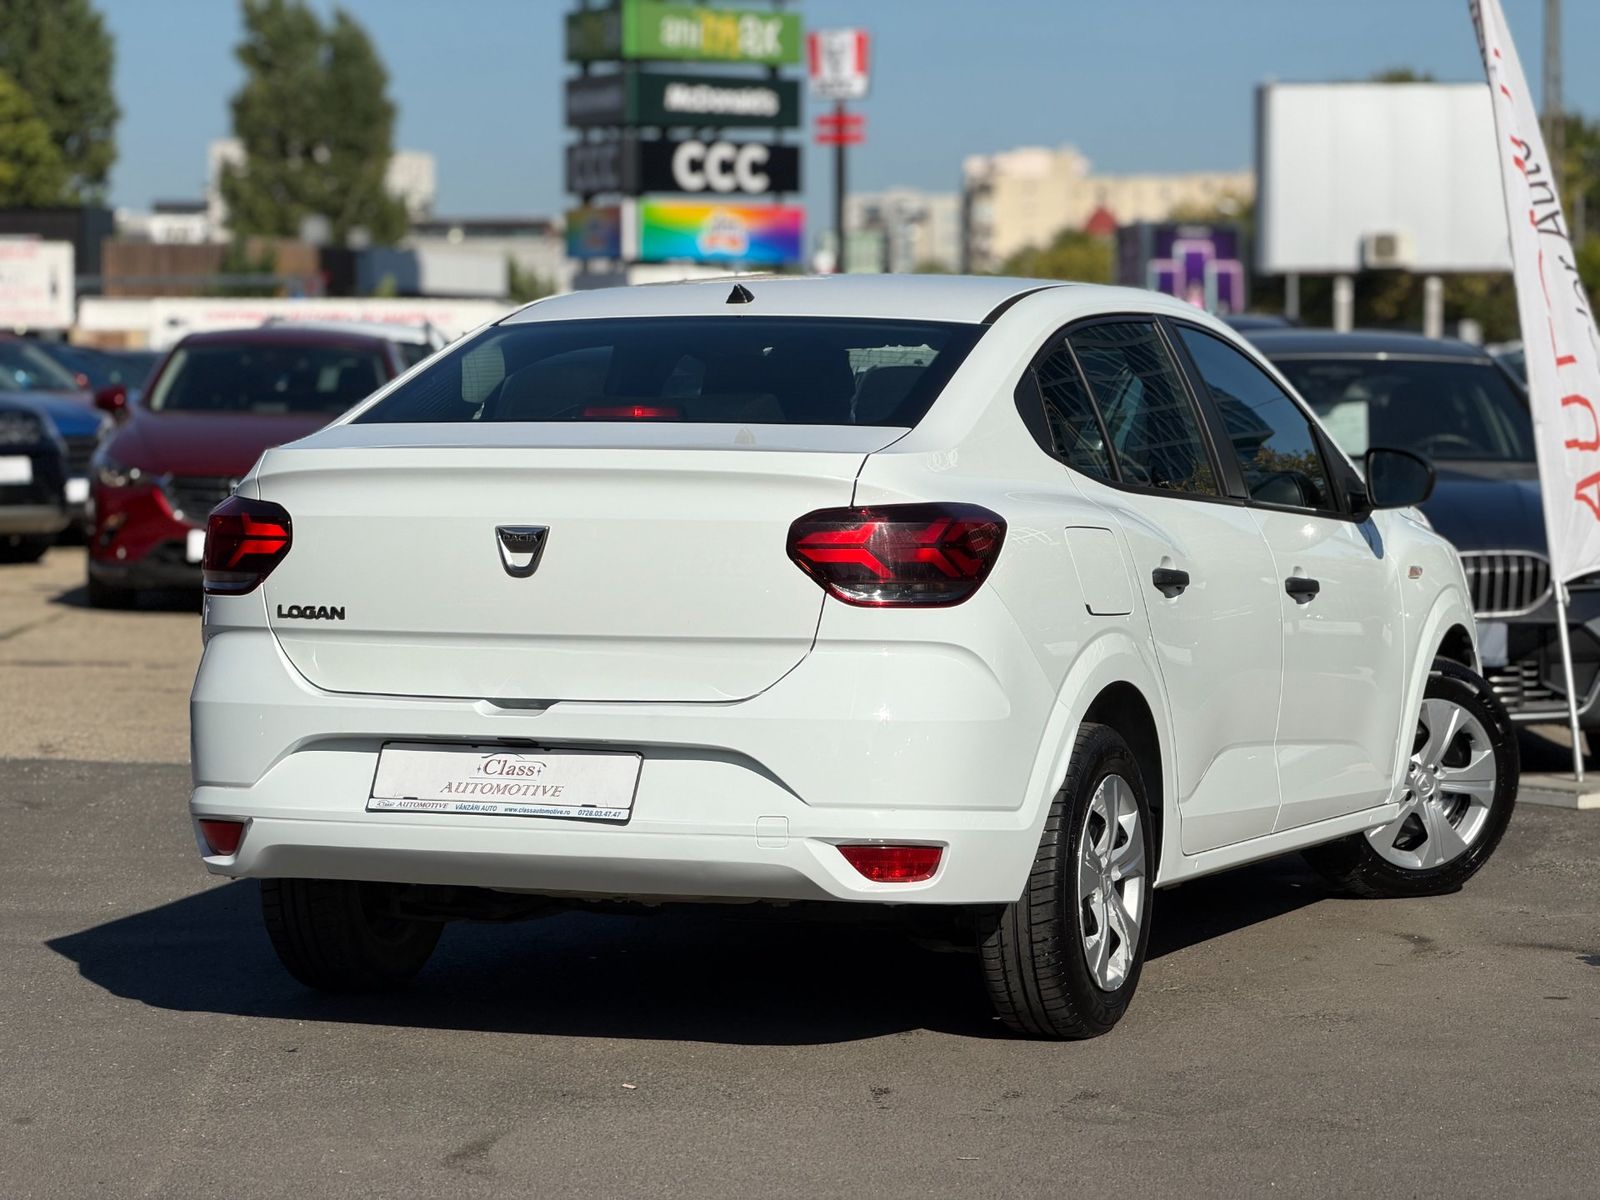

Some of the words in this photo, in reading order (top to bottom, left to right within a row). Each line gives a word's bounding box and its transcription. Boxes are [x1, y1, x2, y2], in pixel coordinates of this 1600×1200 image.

[672, 140, 770, 193] CCC
[277, 604, 346, 620] LOGAN
[483, 759, 536, 777] Class
[441, 782, 564, 797] AUTOMOTIVE
[396, 801, 449, 809] AUTOMOTIVE
[504, 806, 571, 815] www.classautomotive.ro
